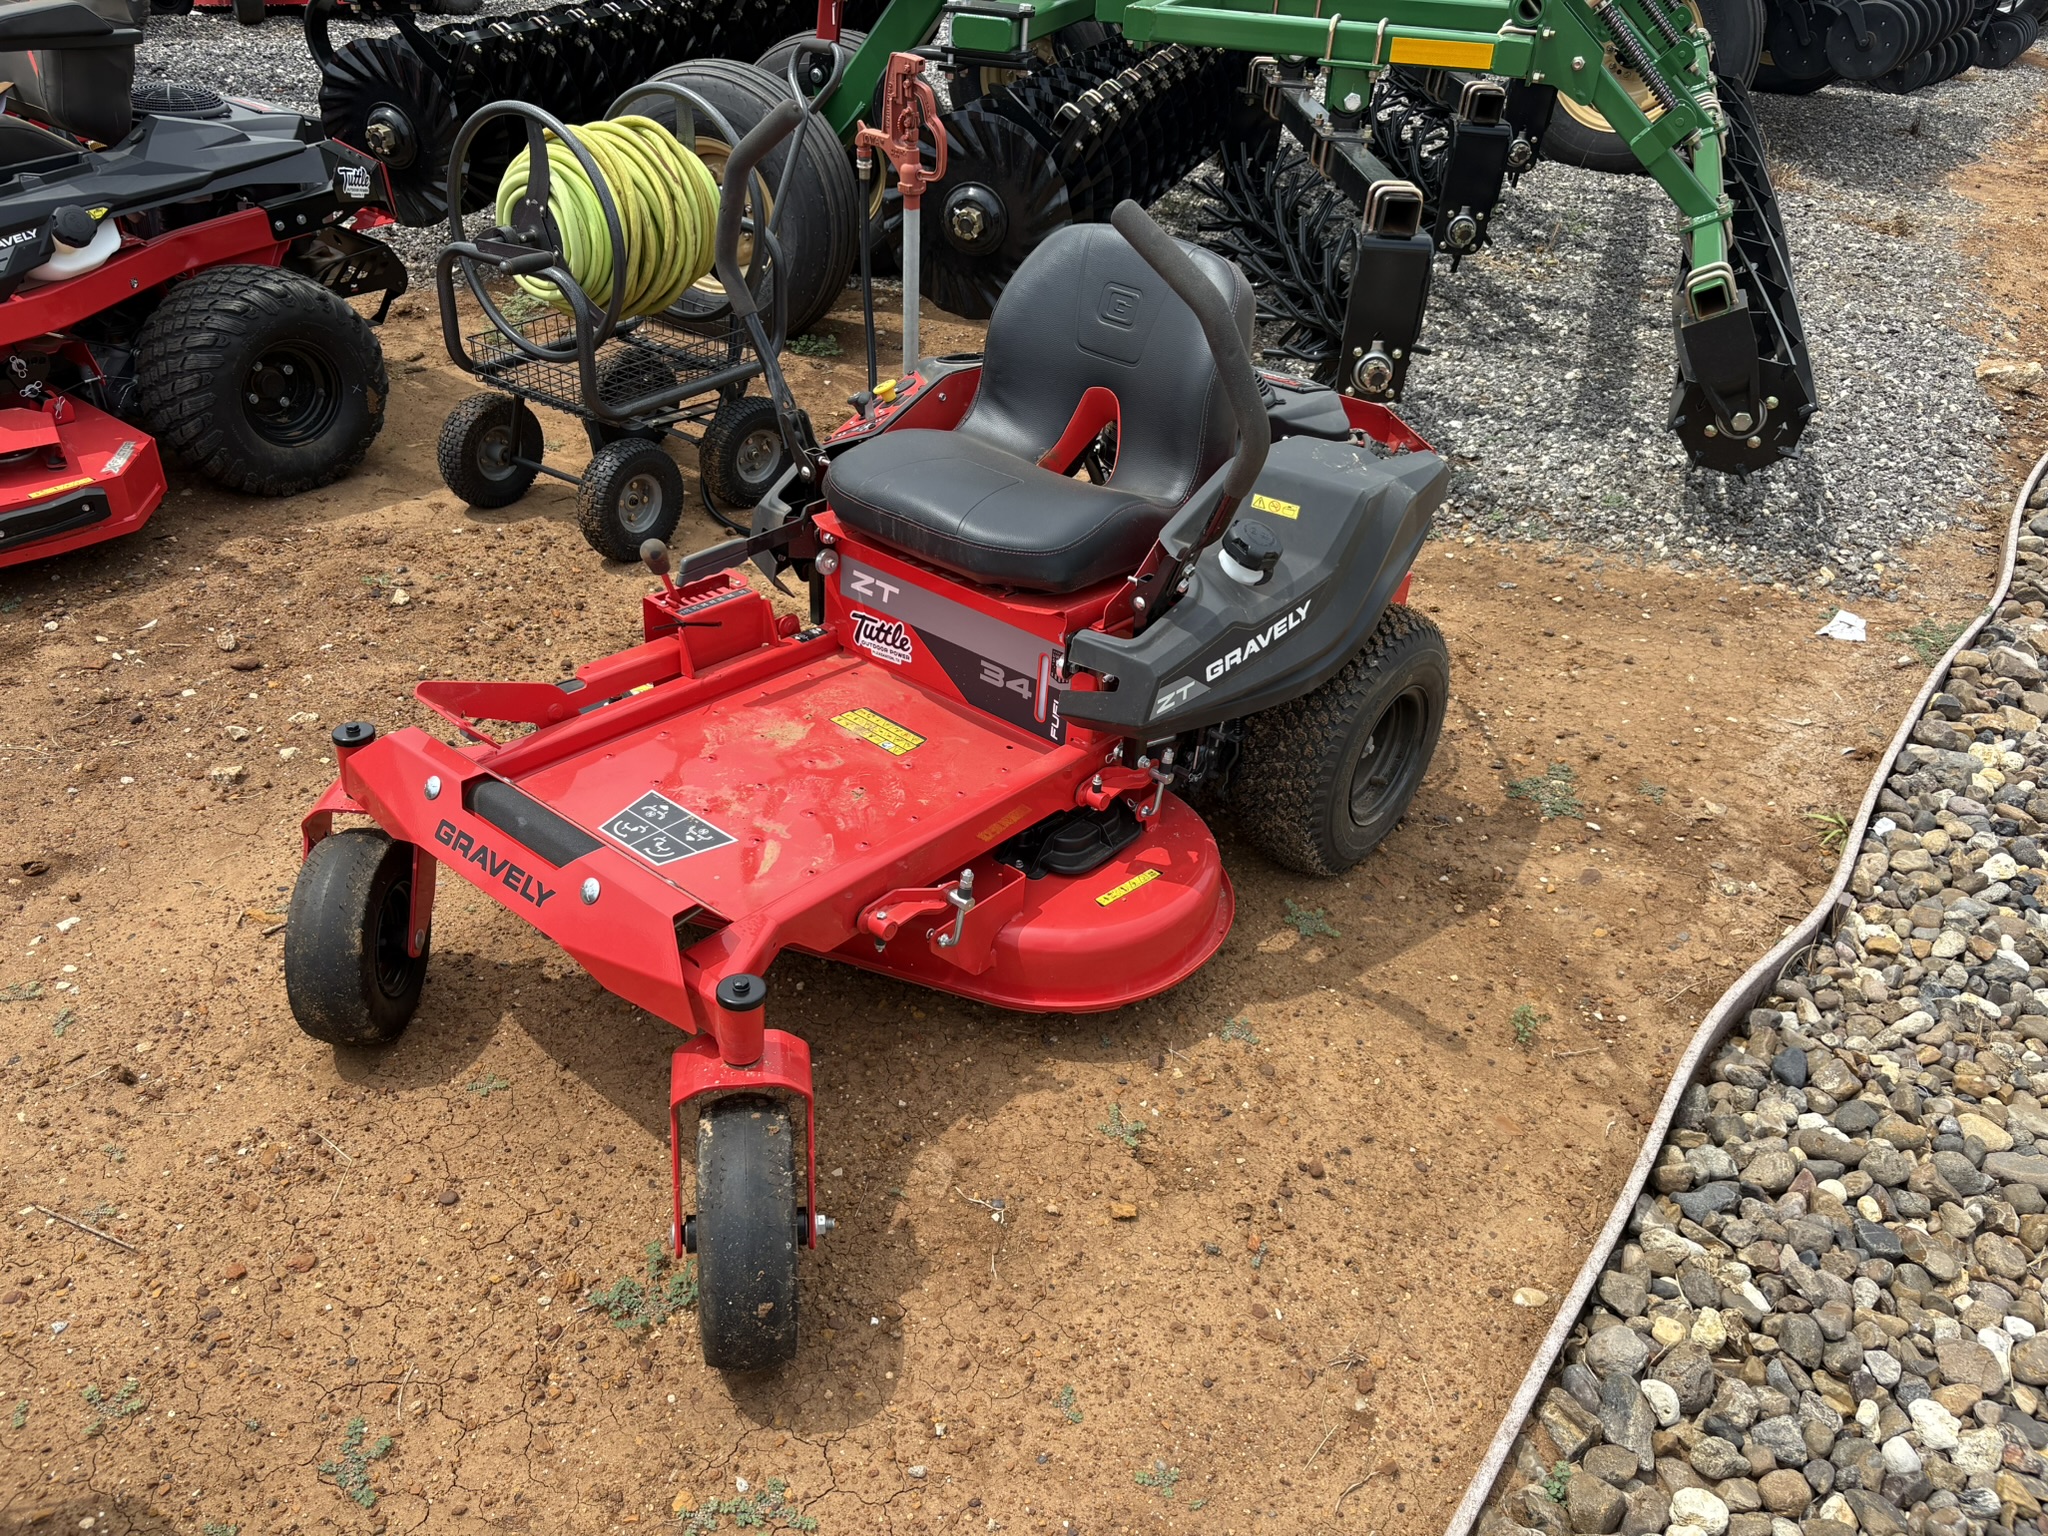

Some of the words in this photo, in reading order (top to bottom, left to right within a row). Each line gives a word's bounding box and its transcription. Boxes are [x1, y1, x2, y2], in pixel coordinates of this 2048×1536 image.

[338, 168, 370, 192] Tuttle
[850, 569, 900, 603] ZT
[851, 612, 911, 652] Tuttle
[861, 639, 889, 653] OUTDOOR
[889, 648, 911, 660] POWER
[1156, 681, 1196, 714] ZT
[1205, 599, 1312, 682] GRAVELY
[980, 659, 1032, 700] 34
[435, 818, 556, 908] GRAVELY
